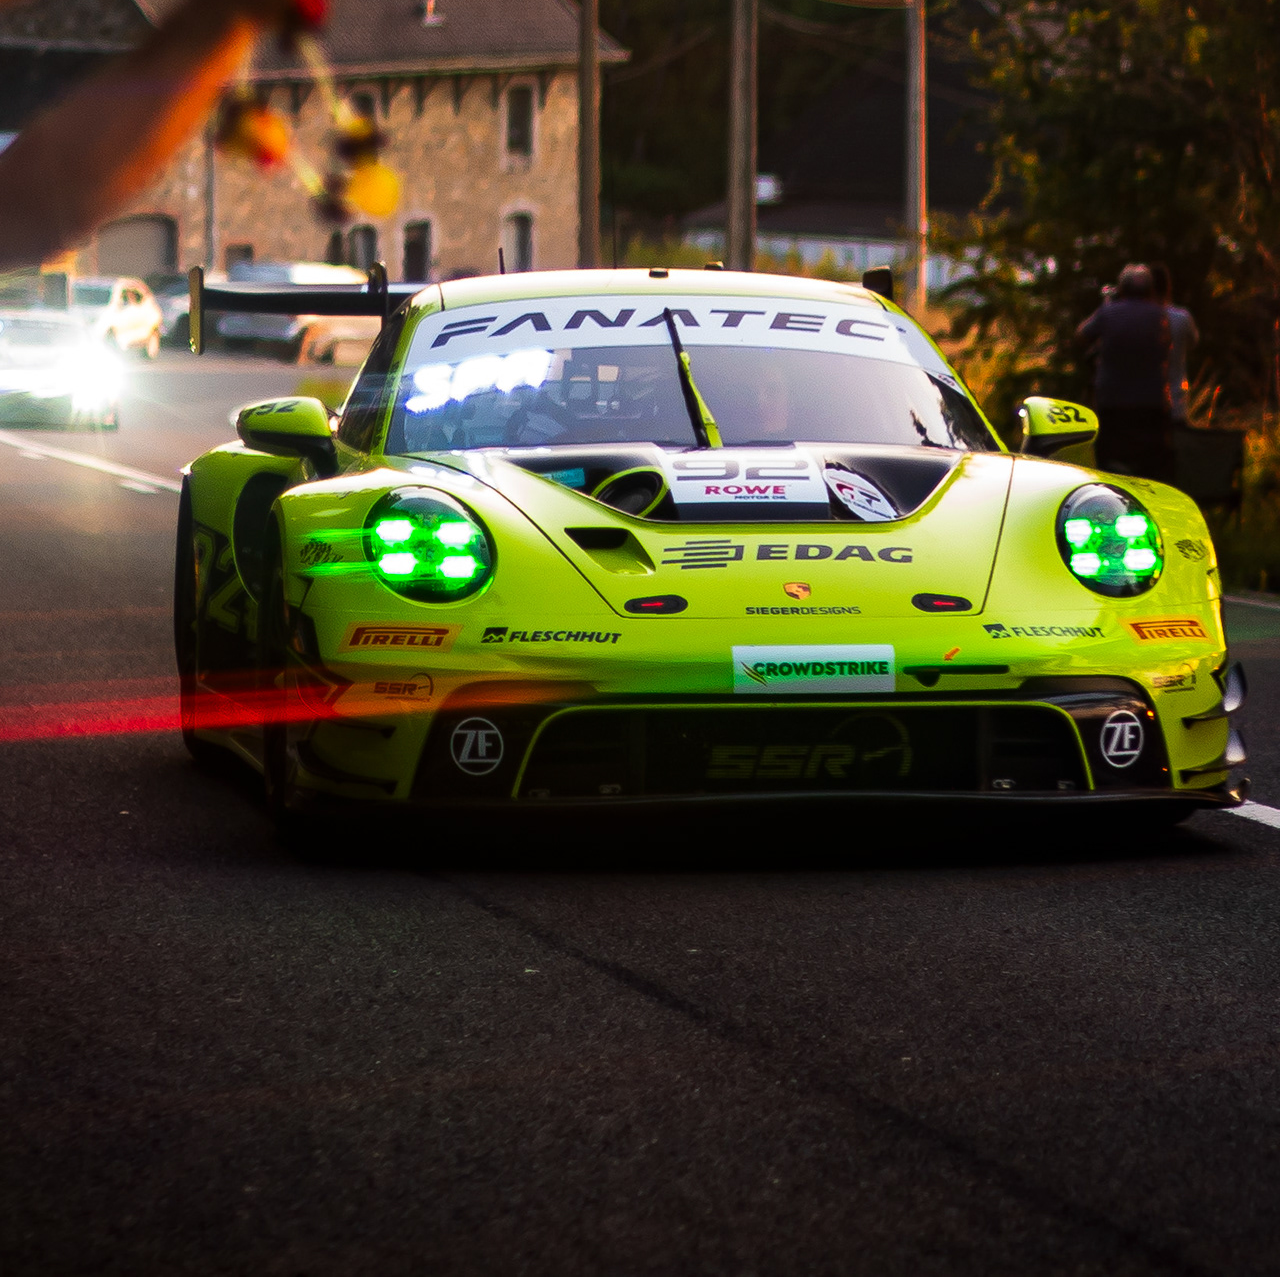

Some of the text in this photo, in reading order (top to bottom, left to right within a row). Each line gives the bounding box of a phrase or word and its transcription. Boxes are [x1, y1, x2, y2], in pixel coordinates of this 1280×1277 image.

[430, 308, 890, 350] FANATEC
[672, 460, 810, 481] 92
[705, 485, 786, 495] ROWE
[756, 544, 913, 563] EDAG
[745, 606, 862, 615] SIEGERDESIGNS
[349, 626, 449, 647] PIRELLI
[508, 630, 622, 644] FLESCHHUT
[1011, 626, 1105, 638] FLESCHHUT
[1130, 620, 1207, 640] PIRELLI
[752, 661, 889, 677] CROWDSTRIKE
[454, 729, 500, 763] ZF
[1105, 722, 1141, 756] ZF
[707, 744, 856, 778] SSR
